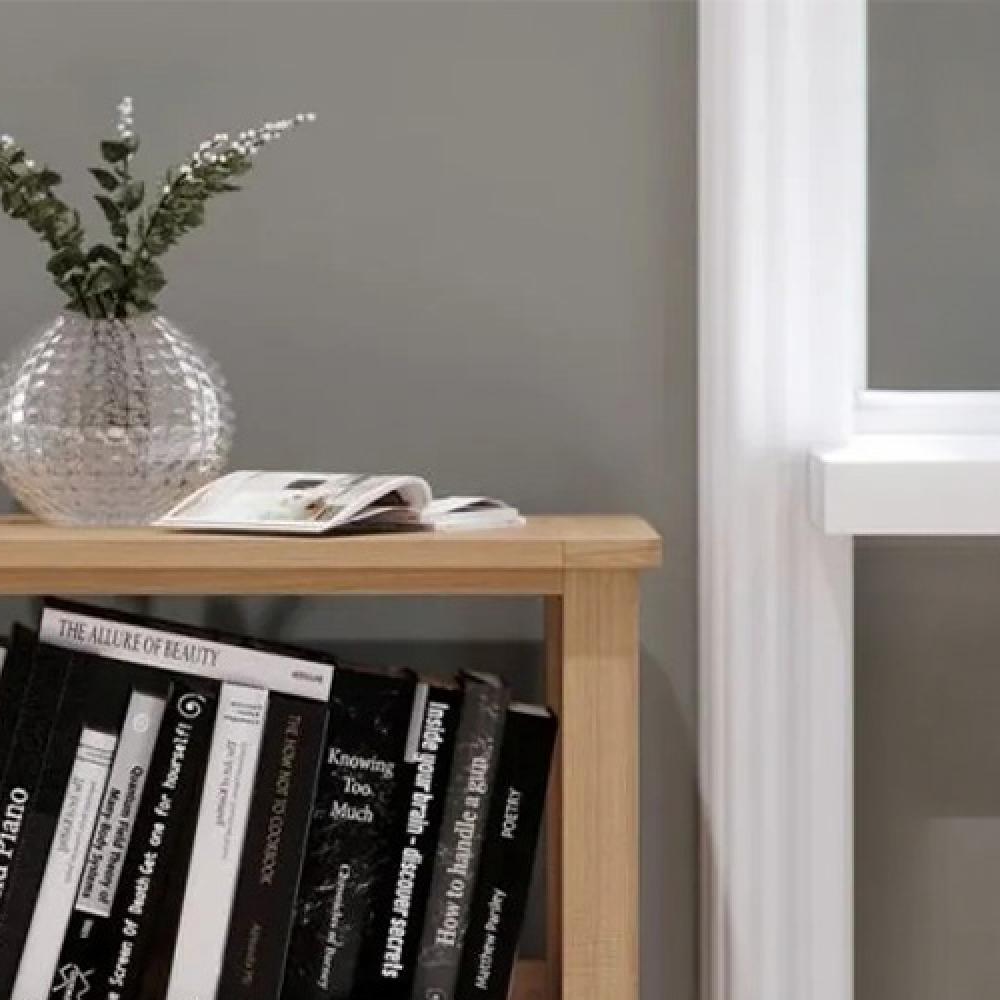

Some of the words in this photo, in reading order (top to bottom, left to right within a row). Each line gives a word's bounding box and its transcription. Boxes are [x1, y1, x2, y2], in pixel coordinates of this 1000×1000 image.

[55, 619, 85, 643] THE
[163, 639, 218, 667] BEAUTY
[421, 701, 449, 751] Inside
[327, 747, 395, 777] Knowing
[413, 750, 437, 793] your
[342, 776, 372, 797] Too
[465, 795, 481, 809] a
[329, 801, 374, 823] Much
[407, 790, 434, 835] brain
[445, 811, 479, 878] handle
[109, 941, 133, 987] Screen
[153, 793, 171, 817] for
[393, 847, 423, 919] discover
[445, 879, 465, 899] to
[435, 901, 461, 947] How
[381, 917, 407, 979] secrets
